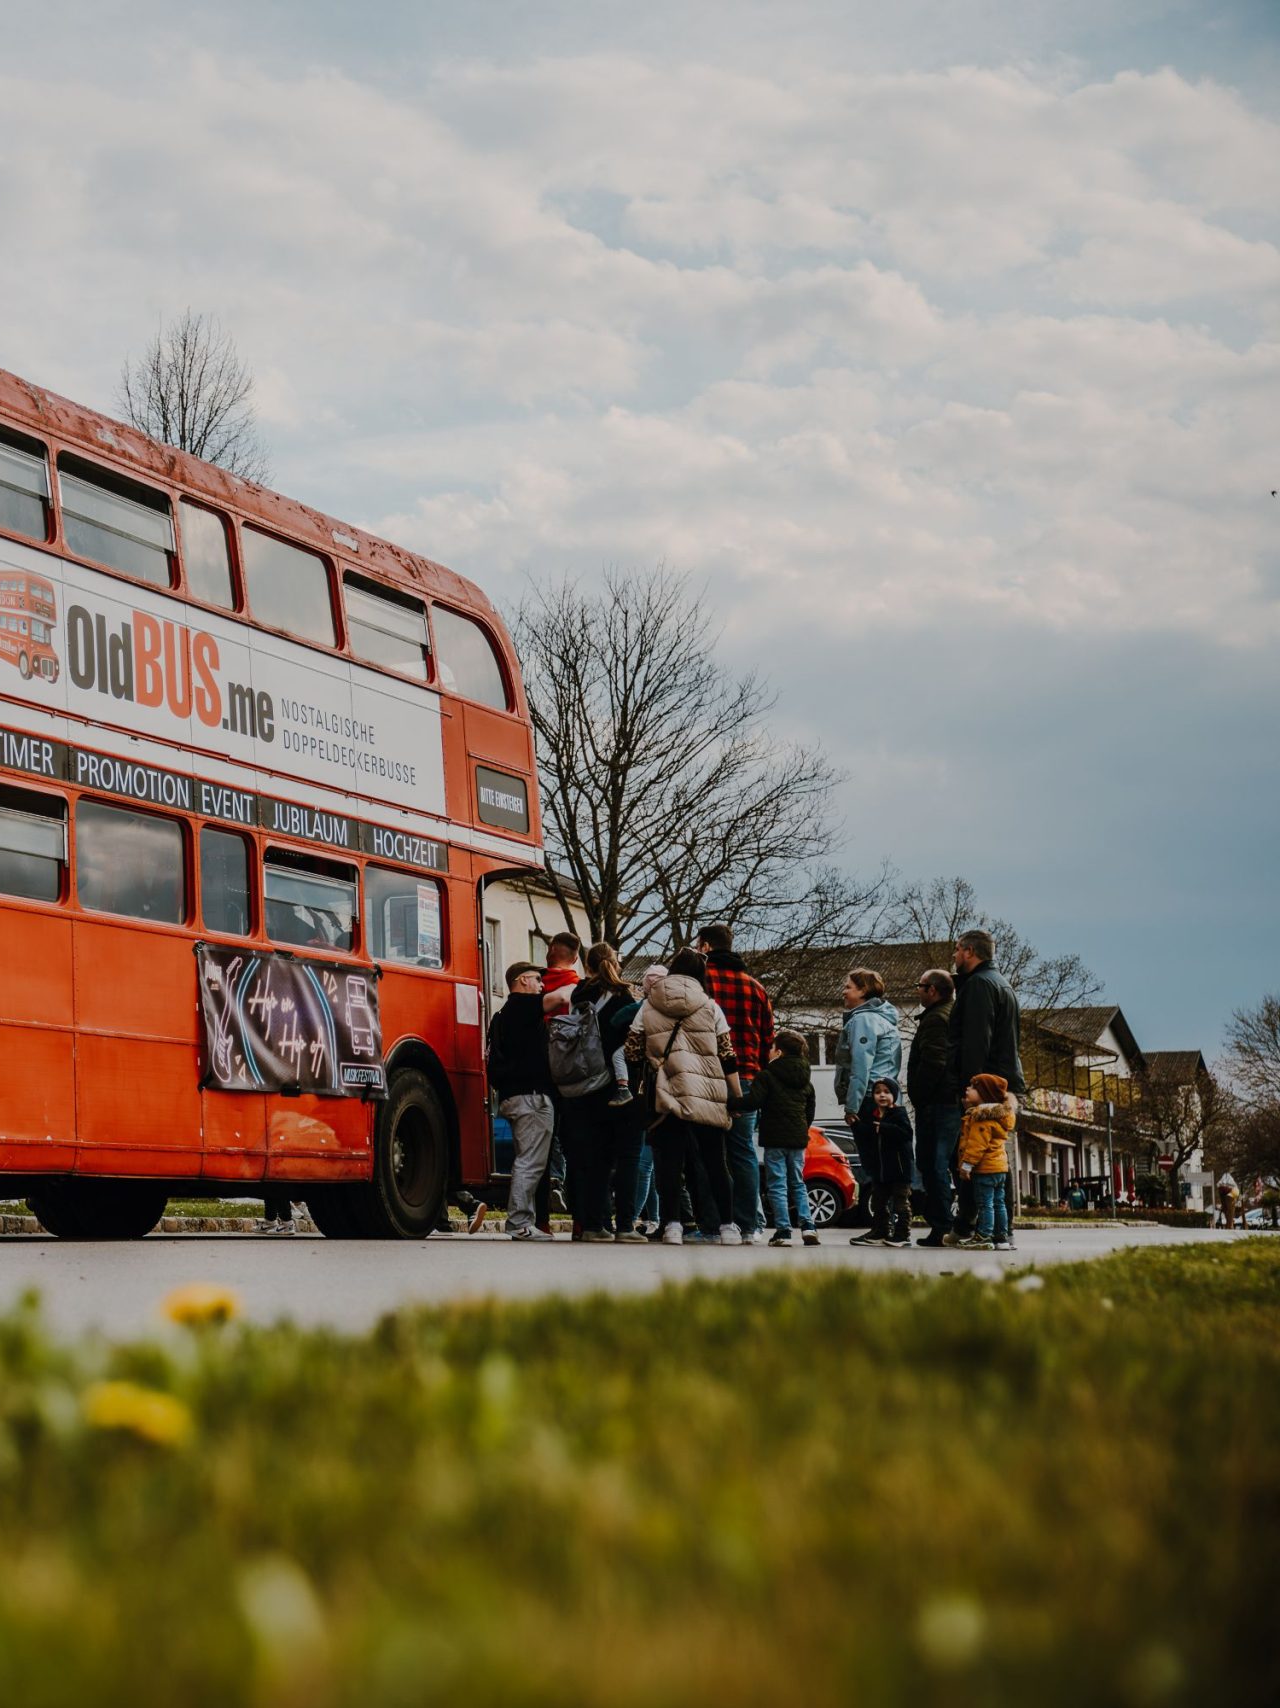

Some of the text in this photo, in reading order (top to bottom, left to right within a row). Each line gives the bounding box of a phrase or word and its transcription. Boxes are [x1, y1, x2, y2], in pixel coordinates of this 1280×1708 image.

[67, 604, 275, 743] OldBUS.me
[281, 698, 375, 745] NOSTALGISCHE
[283, 729, 417, 786] DOPPELDECKERBUSSE
[77, 752, 190, 808] PROMOTION
[201, 784, 253, 823] EVENT
[273, 803, 348, 846] JUBILÄUM
[373, 828, 438, 867] HOCHZEIT
